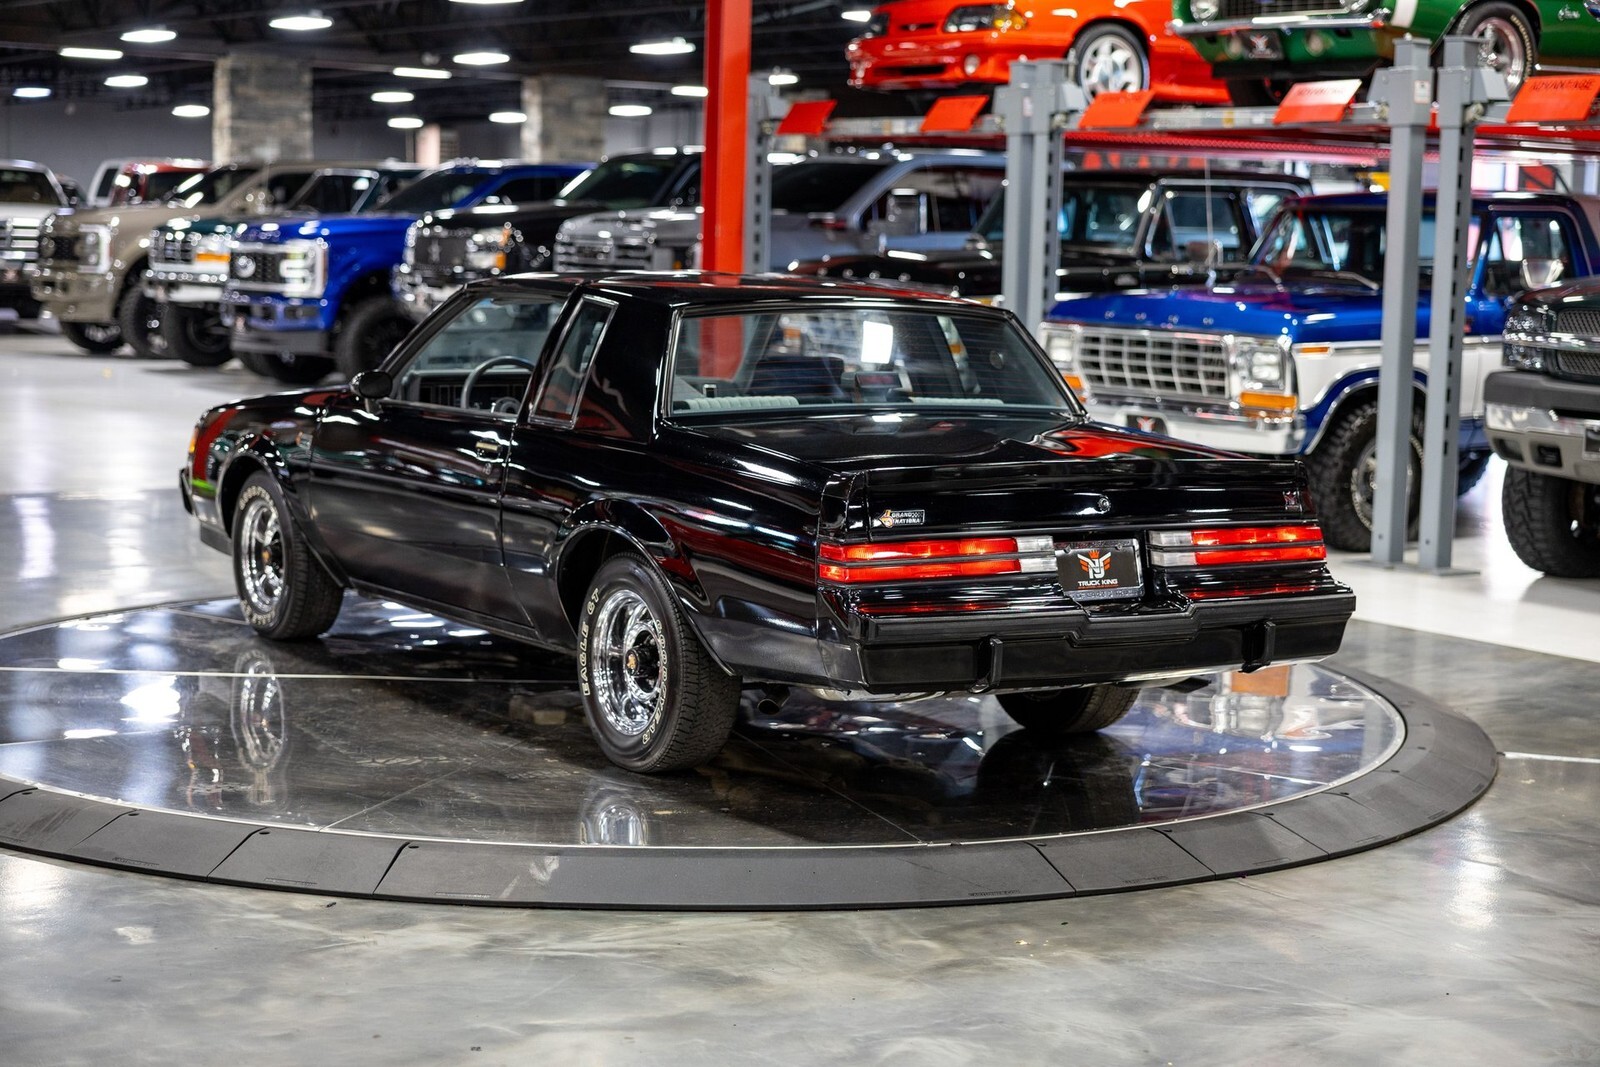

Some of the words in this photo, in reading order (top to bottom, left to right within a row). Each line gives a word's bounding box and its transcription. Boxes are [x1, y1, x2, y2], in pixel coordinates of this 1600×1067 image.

[579, 621, 591, 696] EAGLE
[586, 588, 600, 616] GT
[642, 619, 668, 745] GOODYEAR
